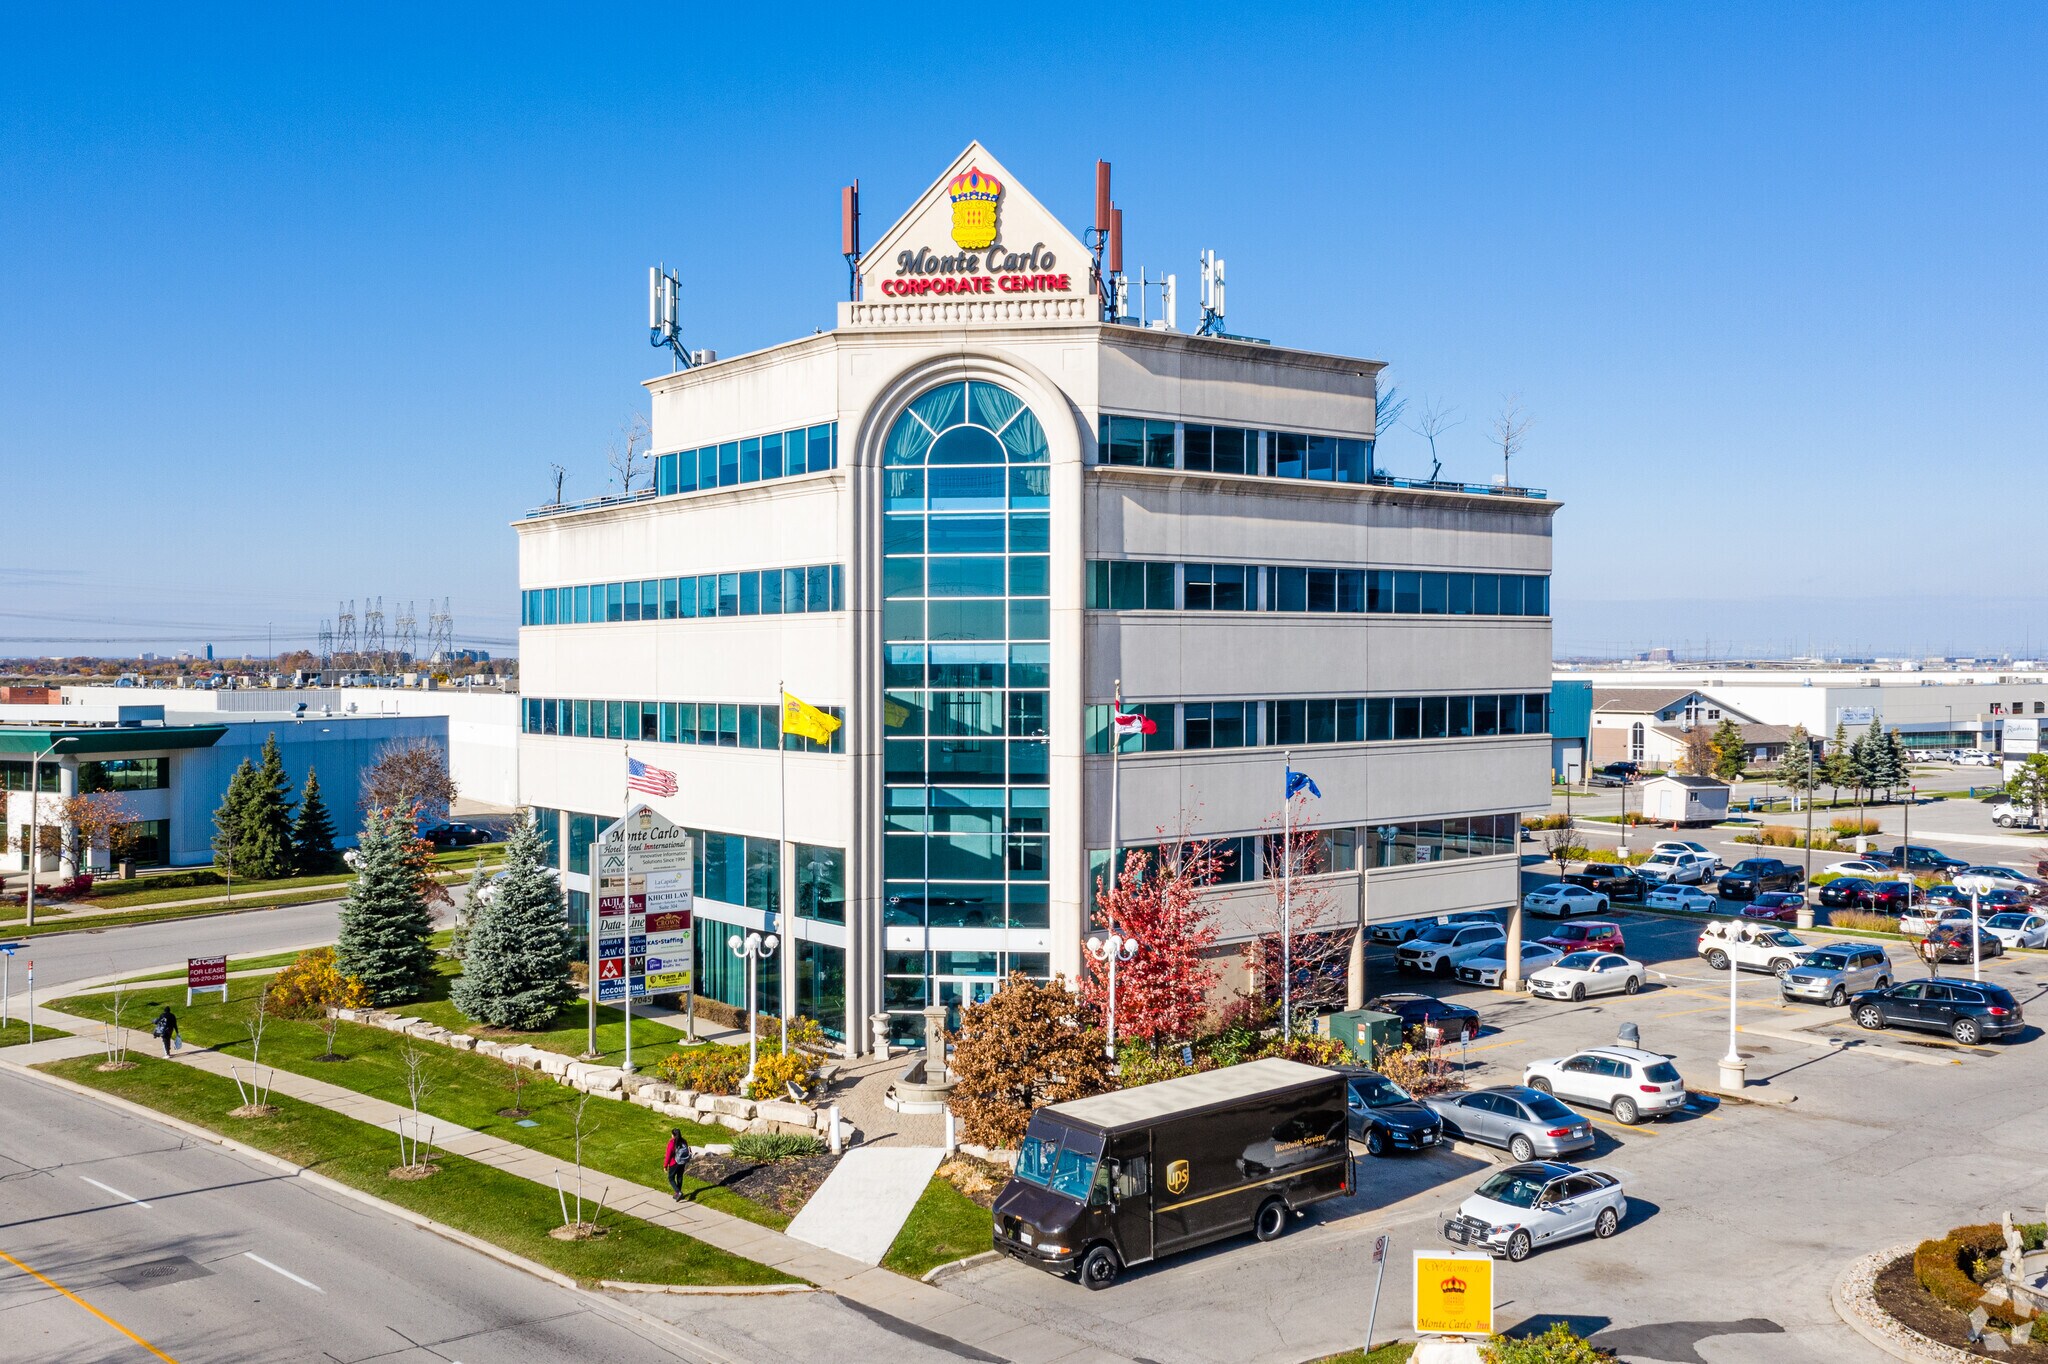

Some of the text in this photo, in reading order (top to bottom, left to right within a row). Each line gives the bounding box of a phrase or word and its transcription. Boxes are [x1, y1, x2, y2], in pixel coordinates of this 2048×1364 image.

[896, 242, 1055, 275] Monte Carlo
[881, 274, 1068, 295] CORPORATE CENTRE
[650, 825, 679, 842] Carlo
[619, 945, 646, 955] OFICE
[601, 984, 643, 995] ACCOUTING
[1275, 1139, 1303, 1152] Worldwide
[1304, 1134, 1325, 1145] Services
[1168, 1168, 1188, 1190] ups
[1418, 1318, 1490, 1330] Monte Carlo Inn
